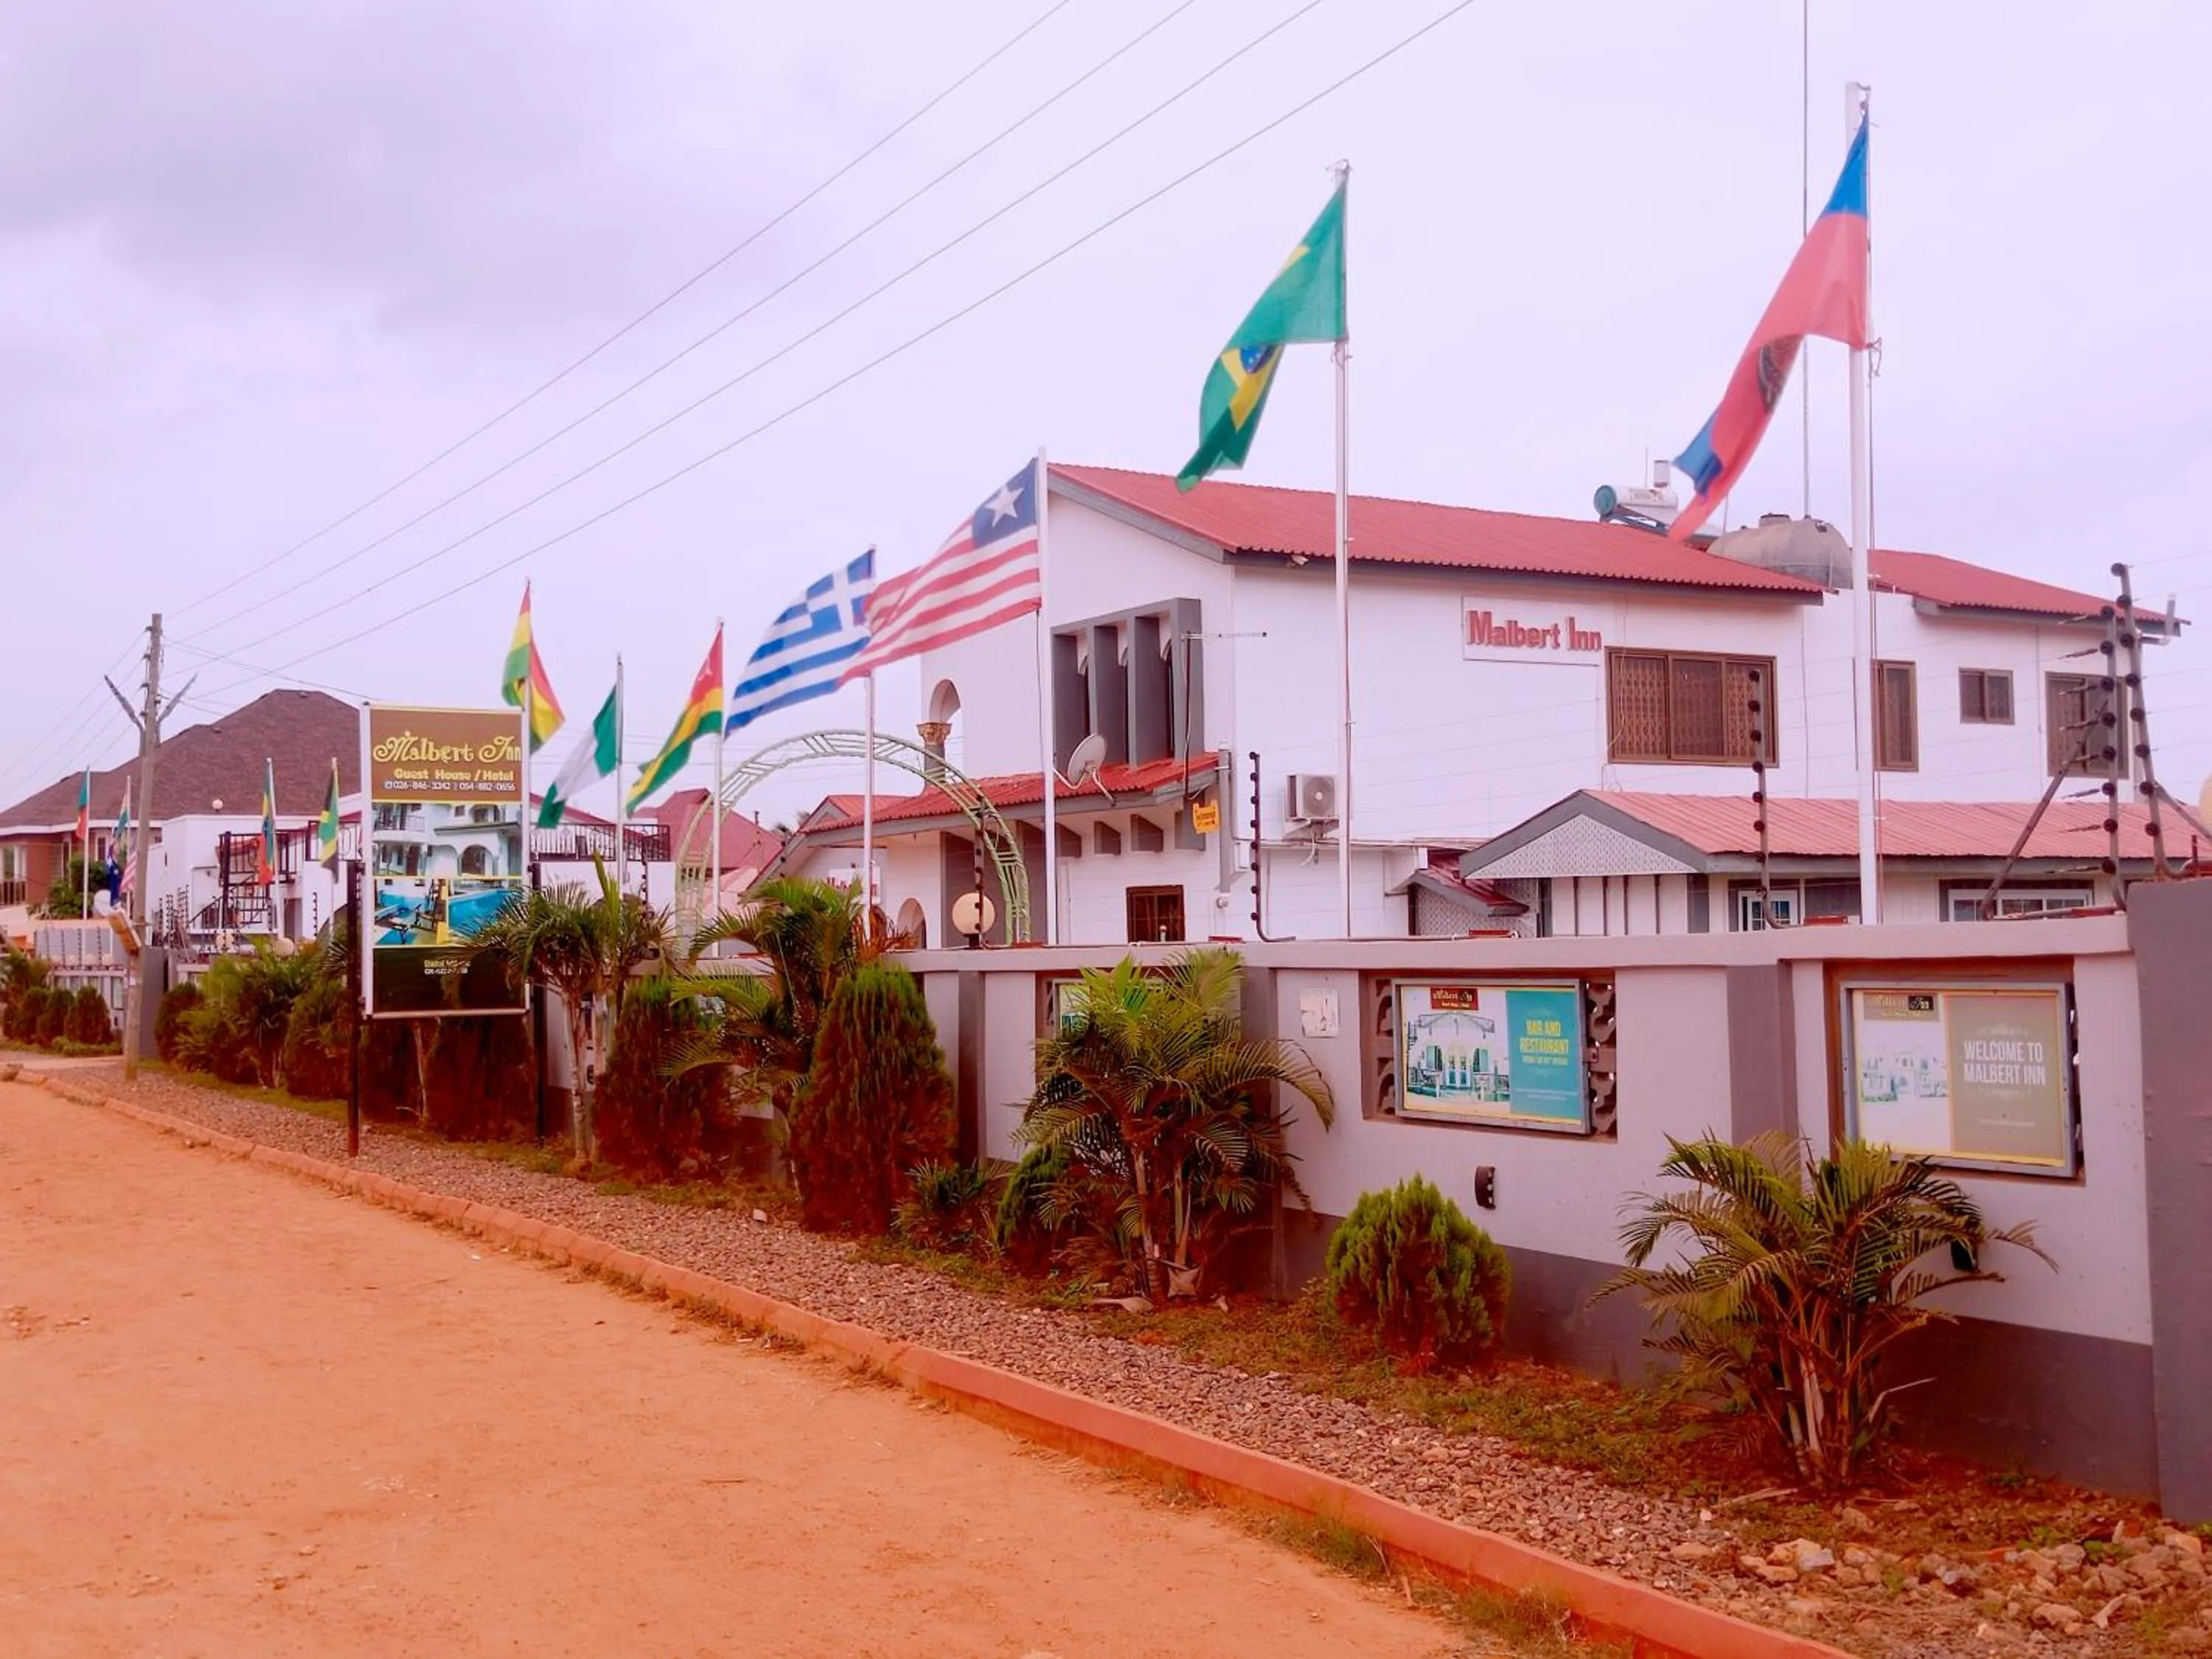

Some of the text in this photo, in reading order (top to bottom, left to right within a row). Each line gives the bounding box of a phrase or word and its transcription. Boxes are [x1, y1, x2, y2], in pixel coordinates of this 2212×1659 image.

[1466, 611, 1601, 651] Malbert Inn
[373, 731, 521, 763] Malbert Inn
[394, 768, 429, 779] Guest
[435, 769, 471, 781] House
[482, 770, 514, 782] Hotel
[1964, 1040, 2043, 1062] WELCOME TO
[1964, 1062, 2046, 1087] MALBERT INN
